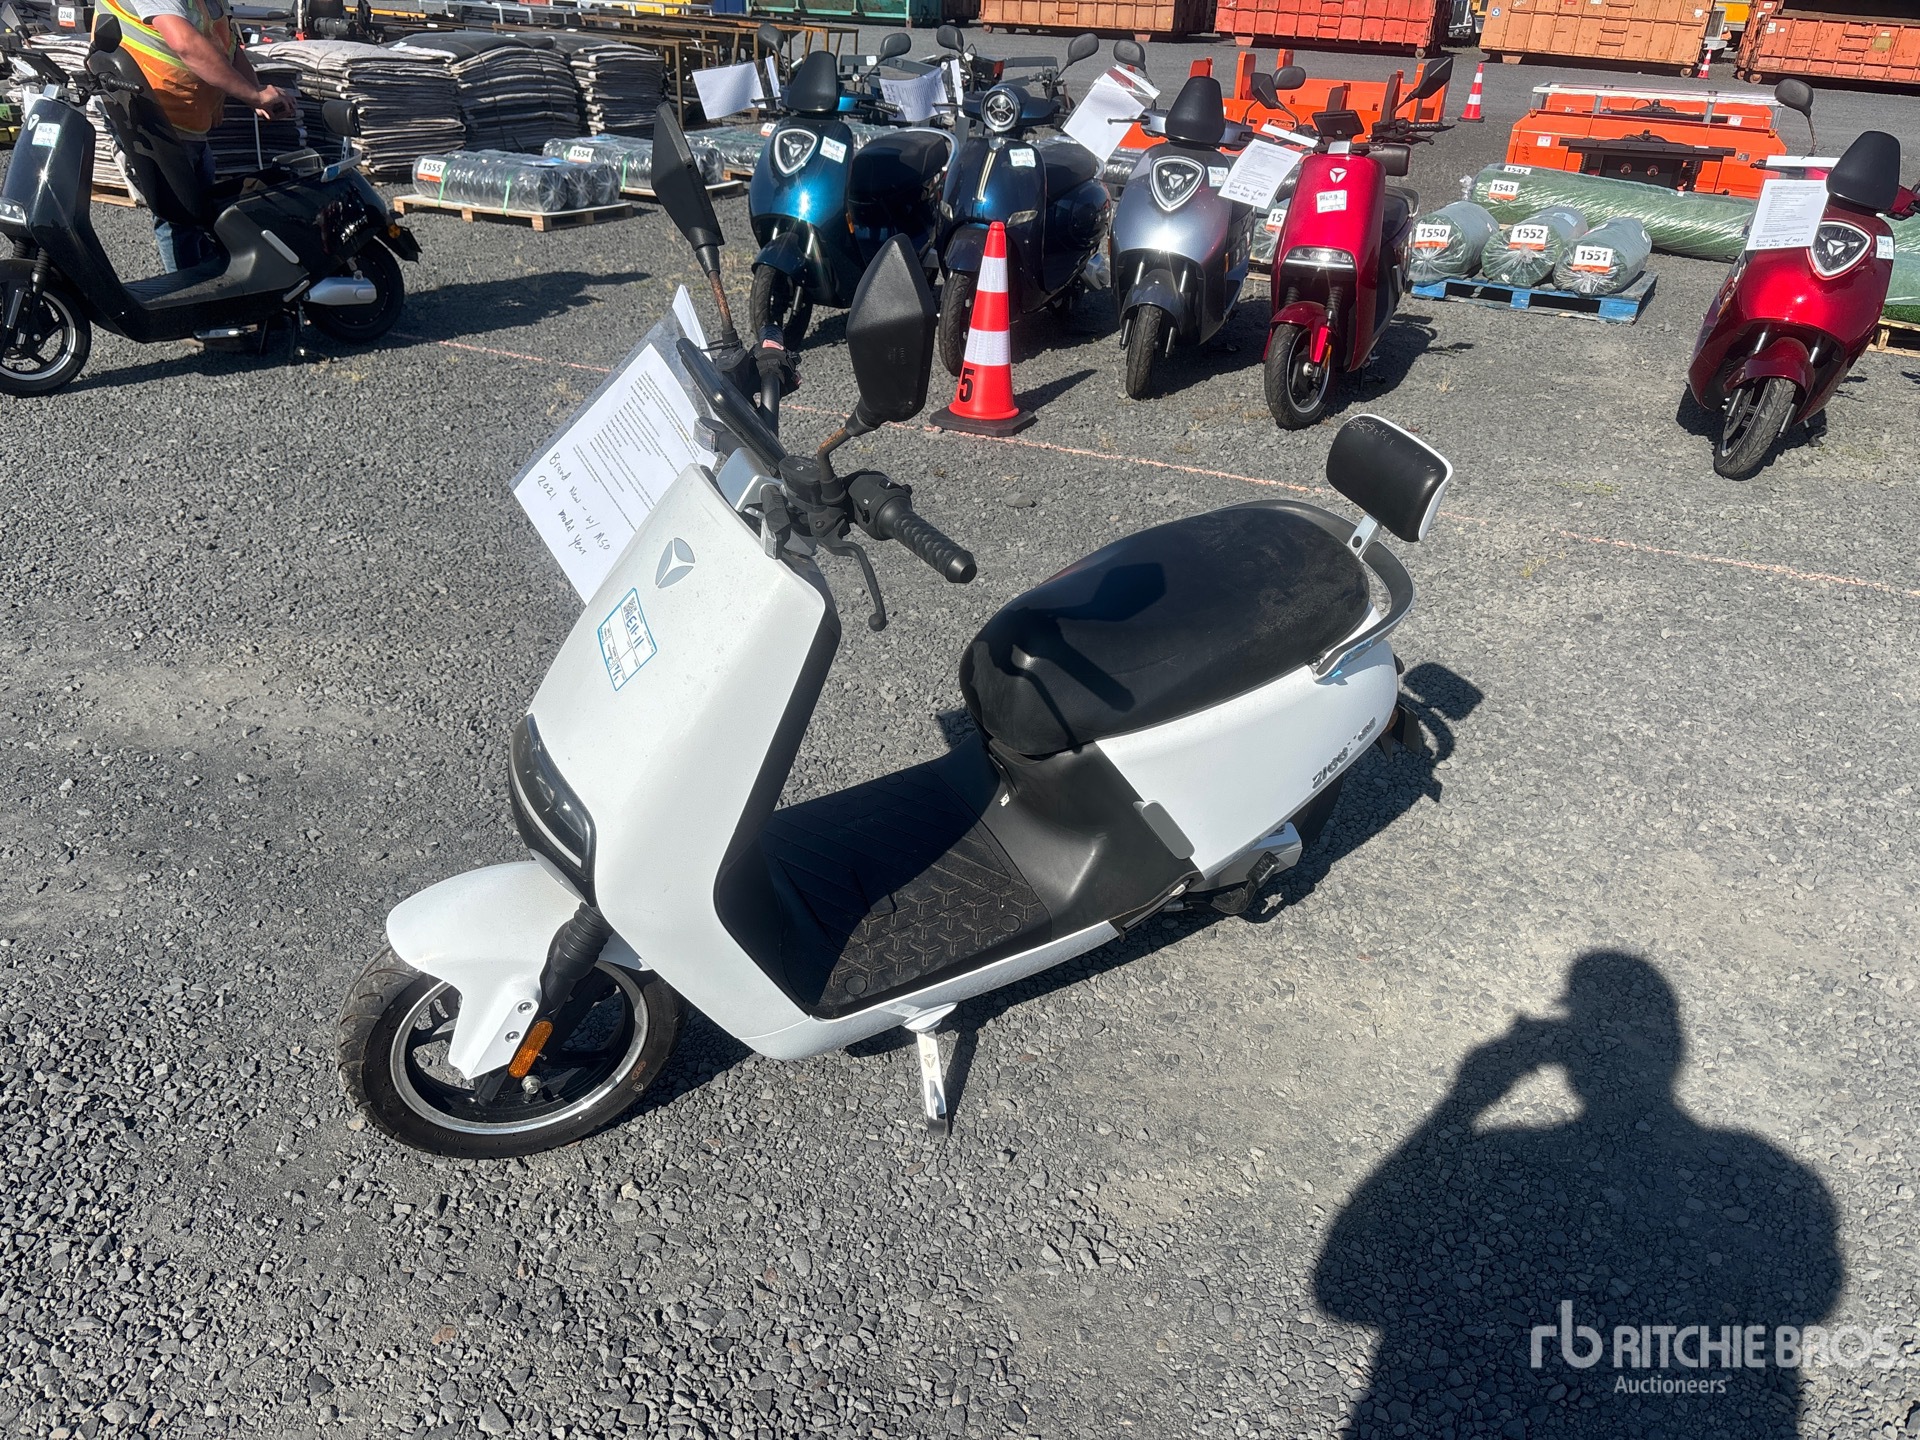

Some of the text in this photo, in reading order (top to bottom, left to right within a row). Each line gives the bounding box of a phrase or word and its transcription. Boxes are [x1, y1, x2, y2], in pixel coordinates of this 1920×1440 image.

[572, 149, 590, 158] 1554
[422, 162, 442, 172] 1555
[1492, 183, 1515, 193] 1543
[1420, 227, 1447, 238] 1550
[1516, 228, 1544, 239] 1552
[1580, 250, 1609, 261] 1551
[958, 367, 975, 403] 5
[549, 452, 572, 482] Brand
[537, 475, 557, 501] 2021
